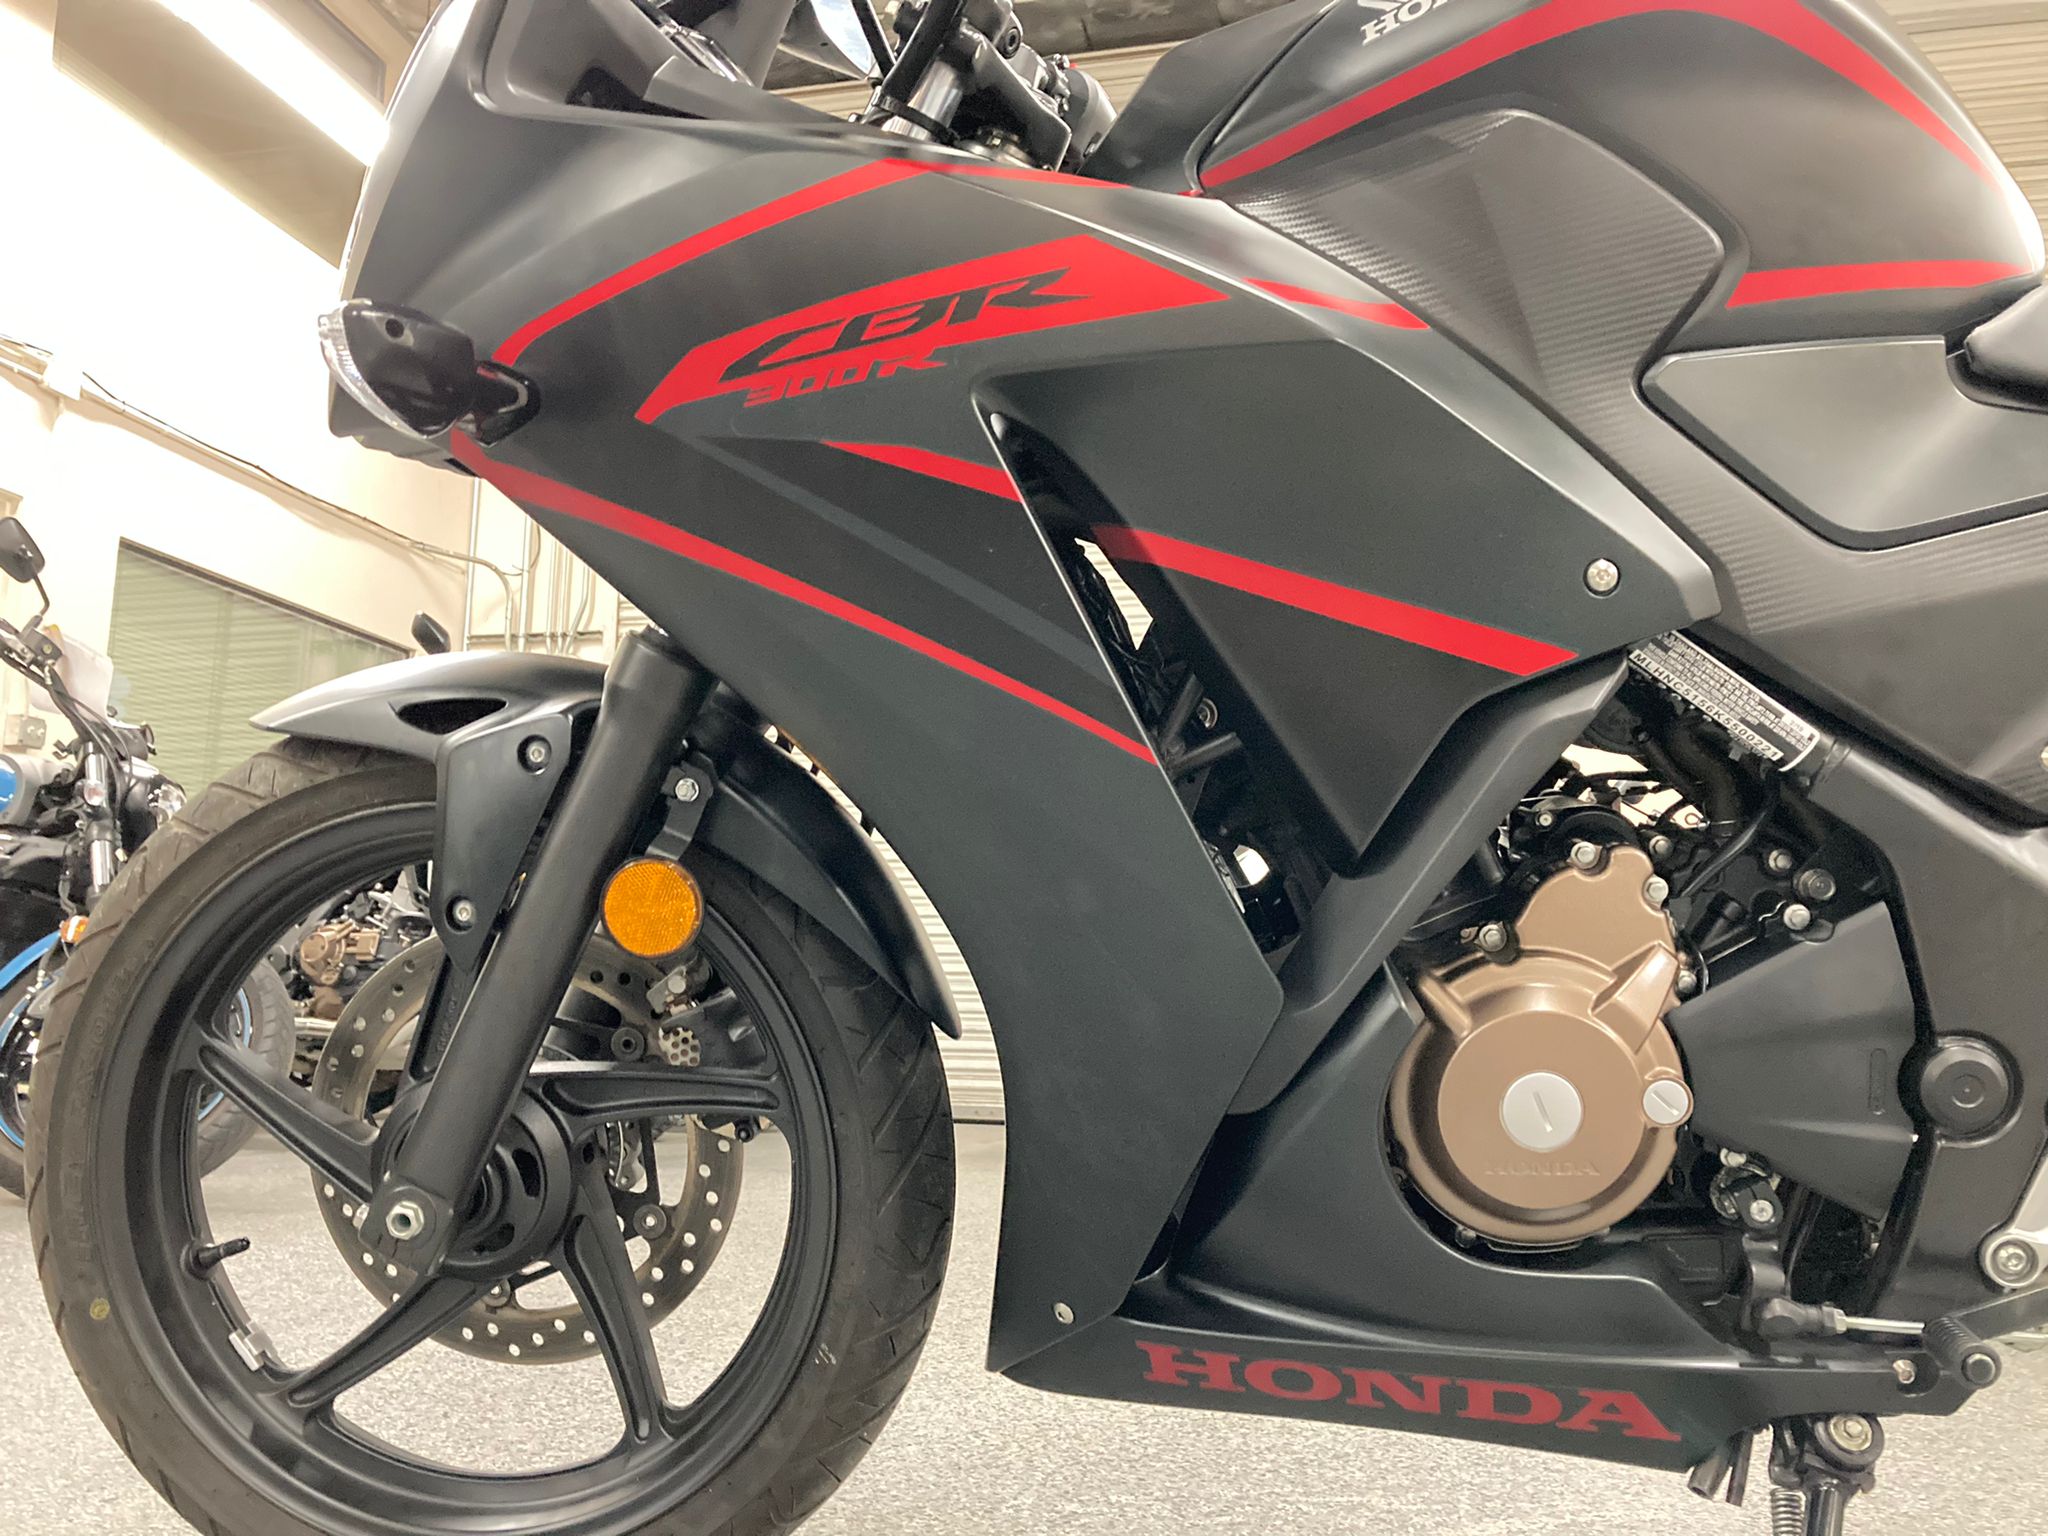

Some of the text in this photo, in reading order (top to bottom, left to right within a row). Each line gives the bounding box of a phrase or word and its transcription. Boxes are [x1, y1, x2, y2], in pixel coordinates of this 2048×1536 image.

[1360, 0, 1448, 46] HO
[718, 267, 1094, 383] CBR
[743, 349, 947, 408] 300R
[1633, 651, 1779, 759] MLHNC5156K5500221
[1485, 1159, 1601, 1176] HONDA
[1136, 1340, 1682, 1442] HONDA
